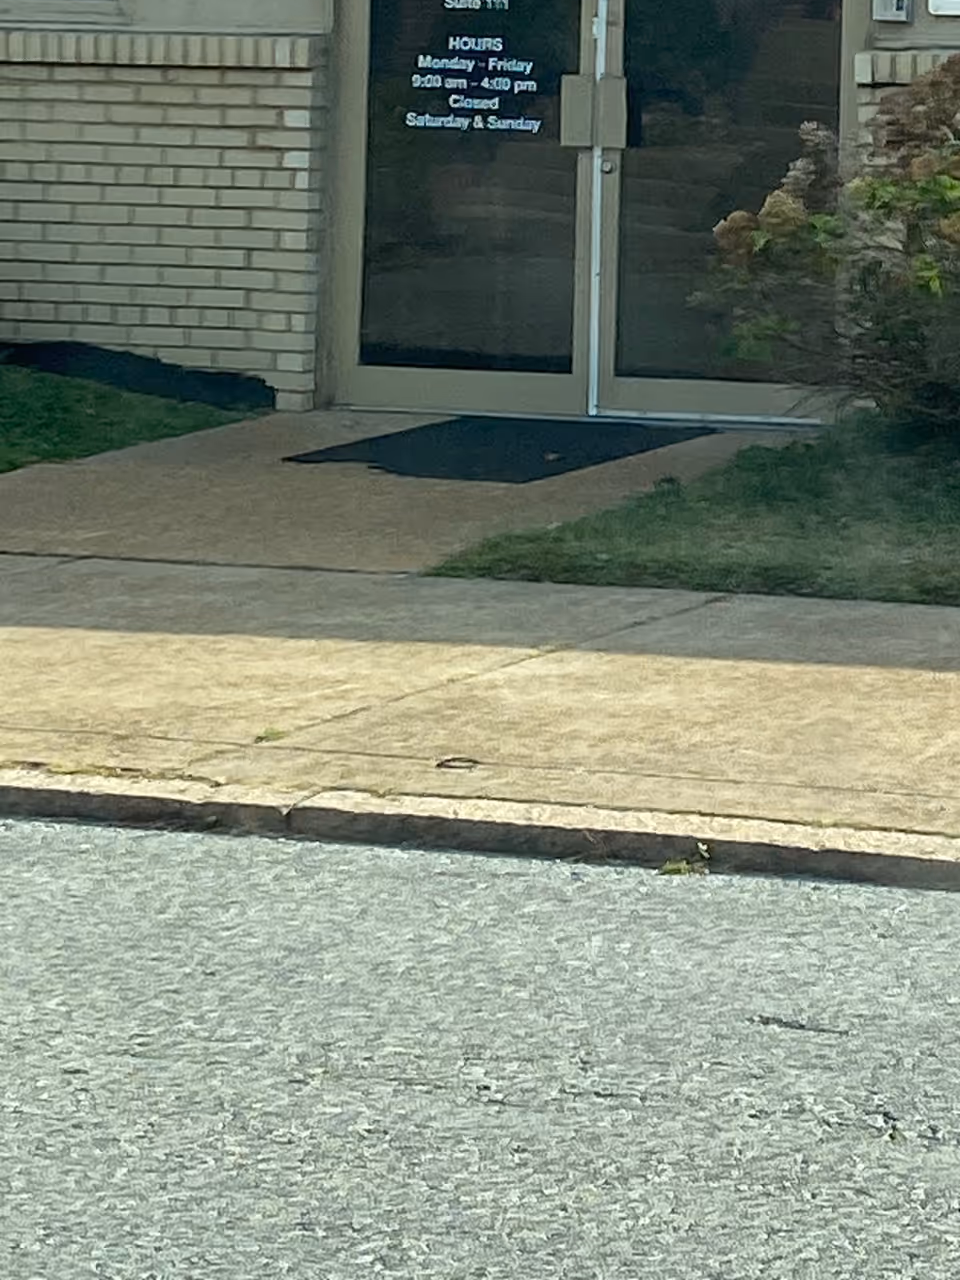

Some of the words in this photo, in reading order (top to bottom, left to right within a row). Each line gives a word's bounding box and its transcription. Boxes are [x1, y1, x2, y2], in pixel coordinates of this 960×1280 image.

[448, 36, 504, 52] HOURS
[417, 54, 476, 73] Monday
[488, 57, 533, 75] Friday
[411, 74, 442, 88] 9:00
[444, 77, 468, 90] am
[480, 76, 512, 91] 4:00
[513, 80, 538, 95] pm
[448, 94, 501, 110] Closed
[405, 111, 471, 131] Saturday
[472, 114, 485, 129] &
[486, 115, 542, 134] Sunday
